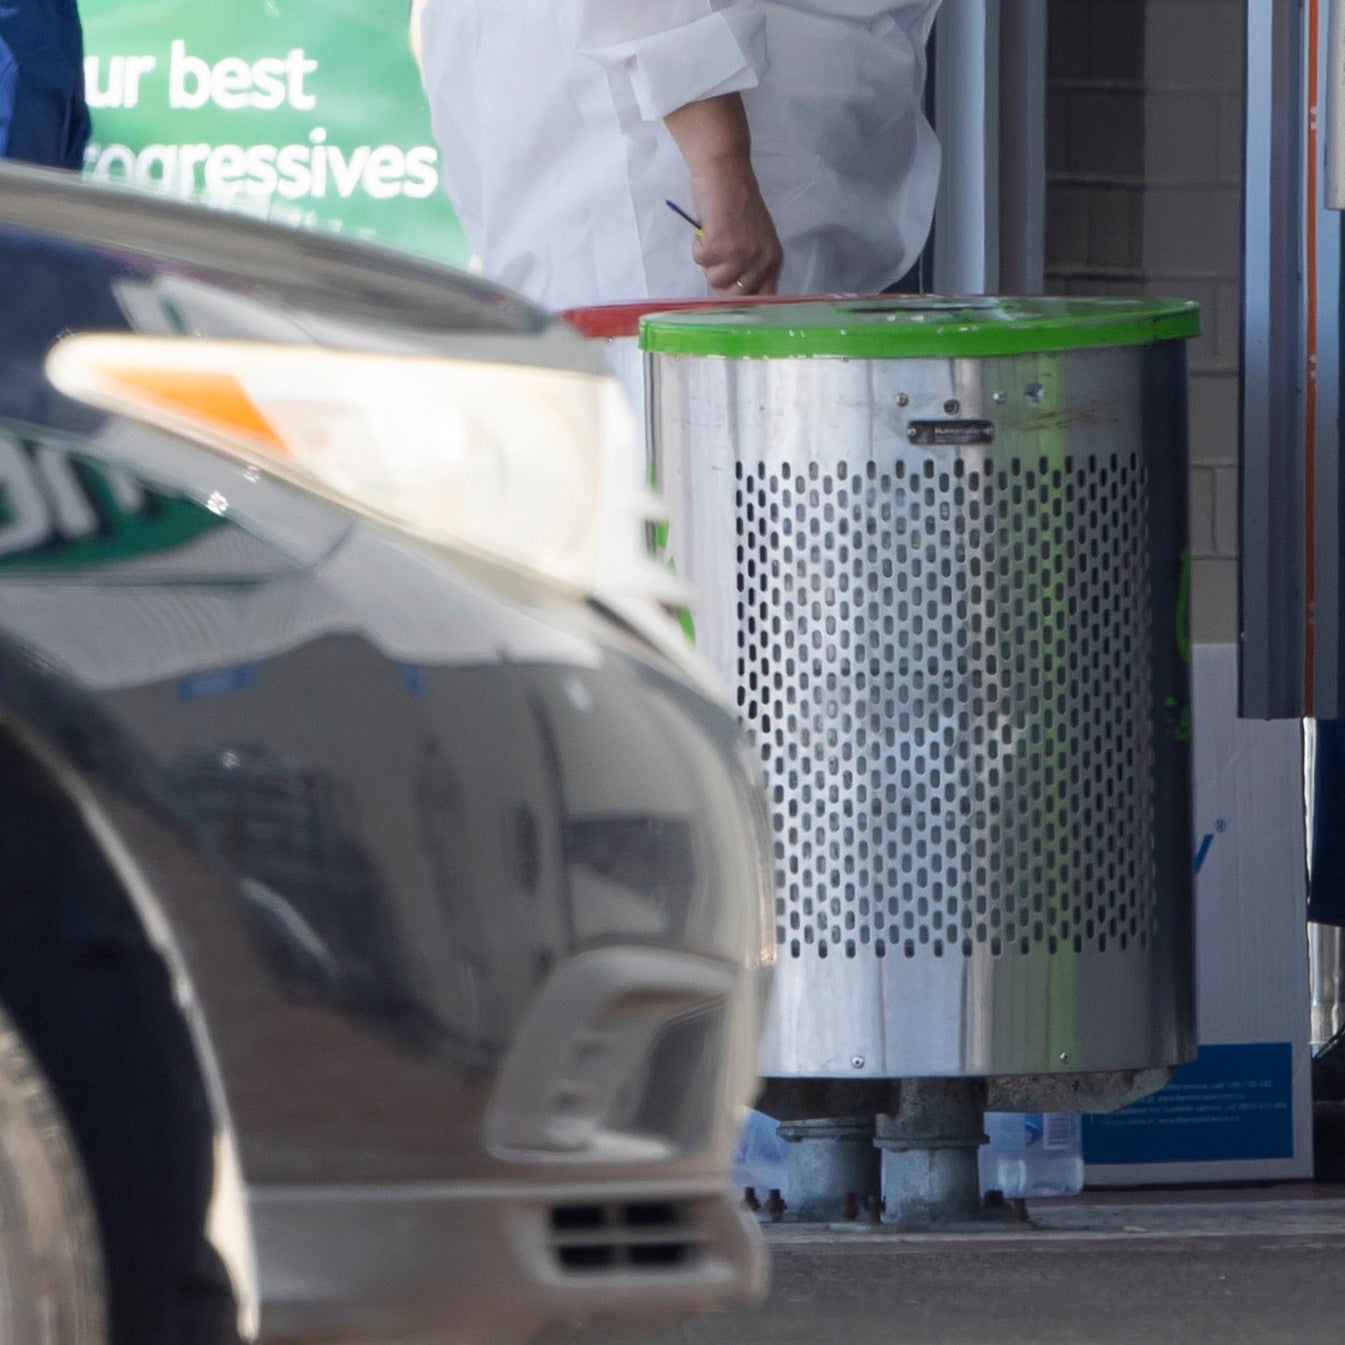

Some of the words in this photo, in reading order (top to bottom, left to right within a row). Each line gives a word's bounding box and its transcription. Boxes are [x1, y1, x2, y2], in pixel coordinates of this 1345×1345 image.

[84, 54, 156, 109] ur
[169, 38, 318, 110] best
[83, 126, 439, 201] ogressives
